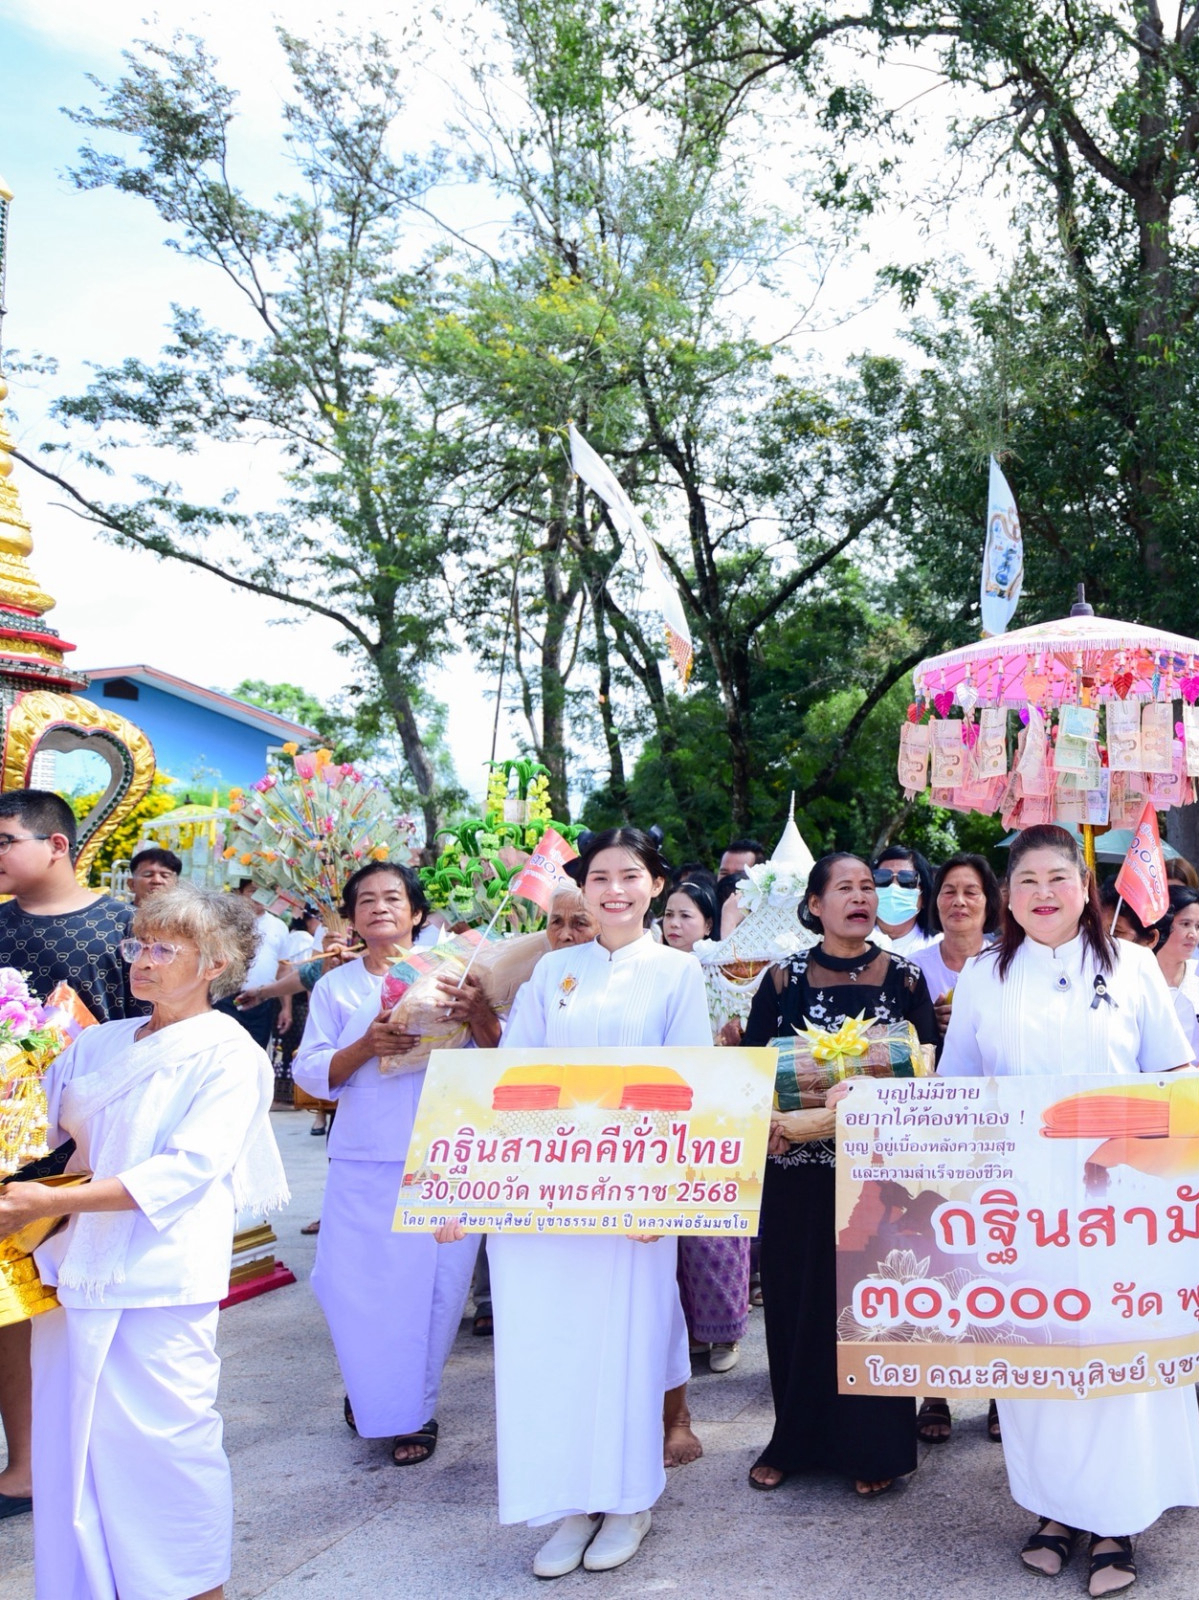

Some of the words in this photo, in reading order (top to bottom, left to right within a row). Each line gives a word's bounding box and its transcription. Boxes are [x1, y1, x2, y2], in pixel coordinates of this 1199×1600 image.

[876, 1081, 981, 1106] บุญไม่มีขาย
[844, 1106, 1010, 1127] อยากได้ต้องทำเอง
[429, 1116, 742, 1175] กฐินสามัคคีทั่วไทย
[844, 1140, 870, 1157] บุญ
[872, 1134, 1017, 1158] อยู่เบื้องหลังความสุข
[851, 1163, 1014, 1180] และความสำเร็จของชีวิต
[538, 1176, 668, 1210] พุทธศักราช
[675, 1182, 738, 1202] 2568
[402, 1211, 426, 1226] โดย
[429, 1211, 533, 1230] คณศิษยานุศิษย์
[537, 1214, 597, 1231] บูชาธรรม
[601, 1216, 618, 1228] 81
[623, 1213, 633, 1228] ปี
[638, 1213, 749, 1230] หลวงพ่อธัมมชโย
[860, 1285, 1092, 1328] ๓๐,๐๐๐
[1111, 1281, 1163, 1319] วัด
[868, 1358, 918, 1384] โดย
[930, 1355, 1146, 1393] คณะศิษยานุศิษย์
